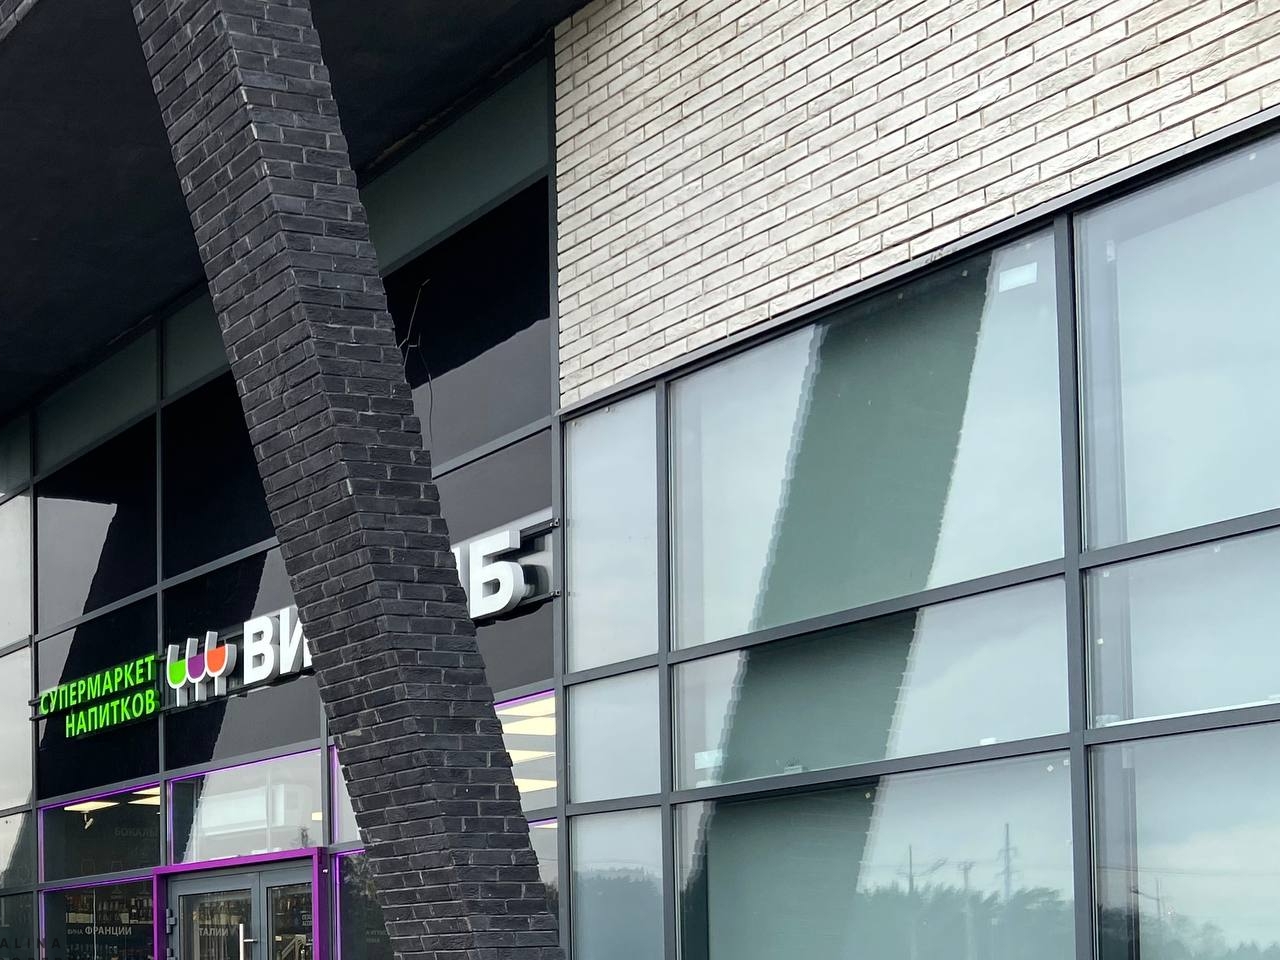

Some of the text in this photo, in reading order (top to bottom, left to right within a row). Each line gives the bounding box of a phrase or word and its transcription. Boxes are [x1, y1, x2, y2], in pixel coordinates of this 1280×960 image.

[40, 655, 155, 715] СУПЕРМАРКЕТ
[65, 689, 156, 738] НАПИТКОВ
[198, 927, 228, 937] ТАЛИИ
